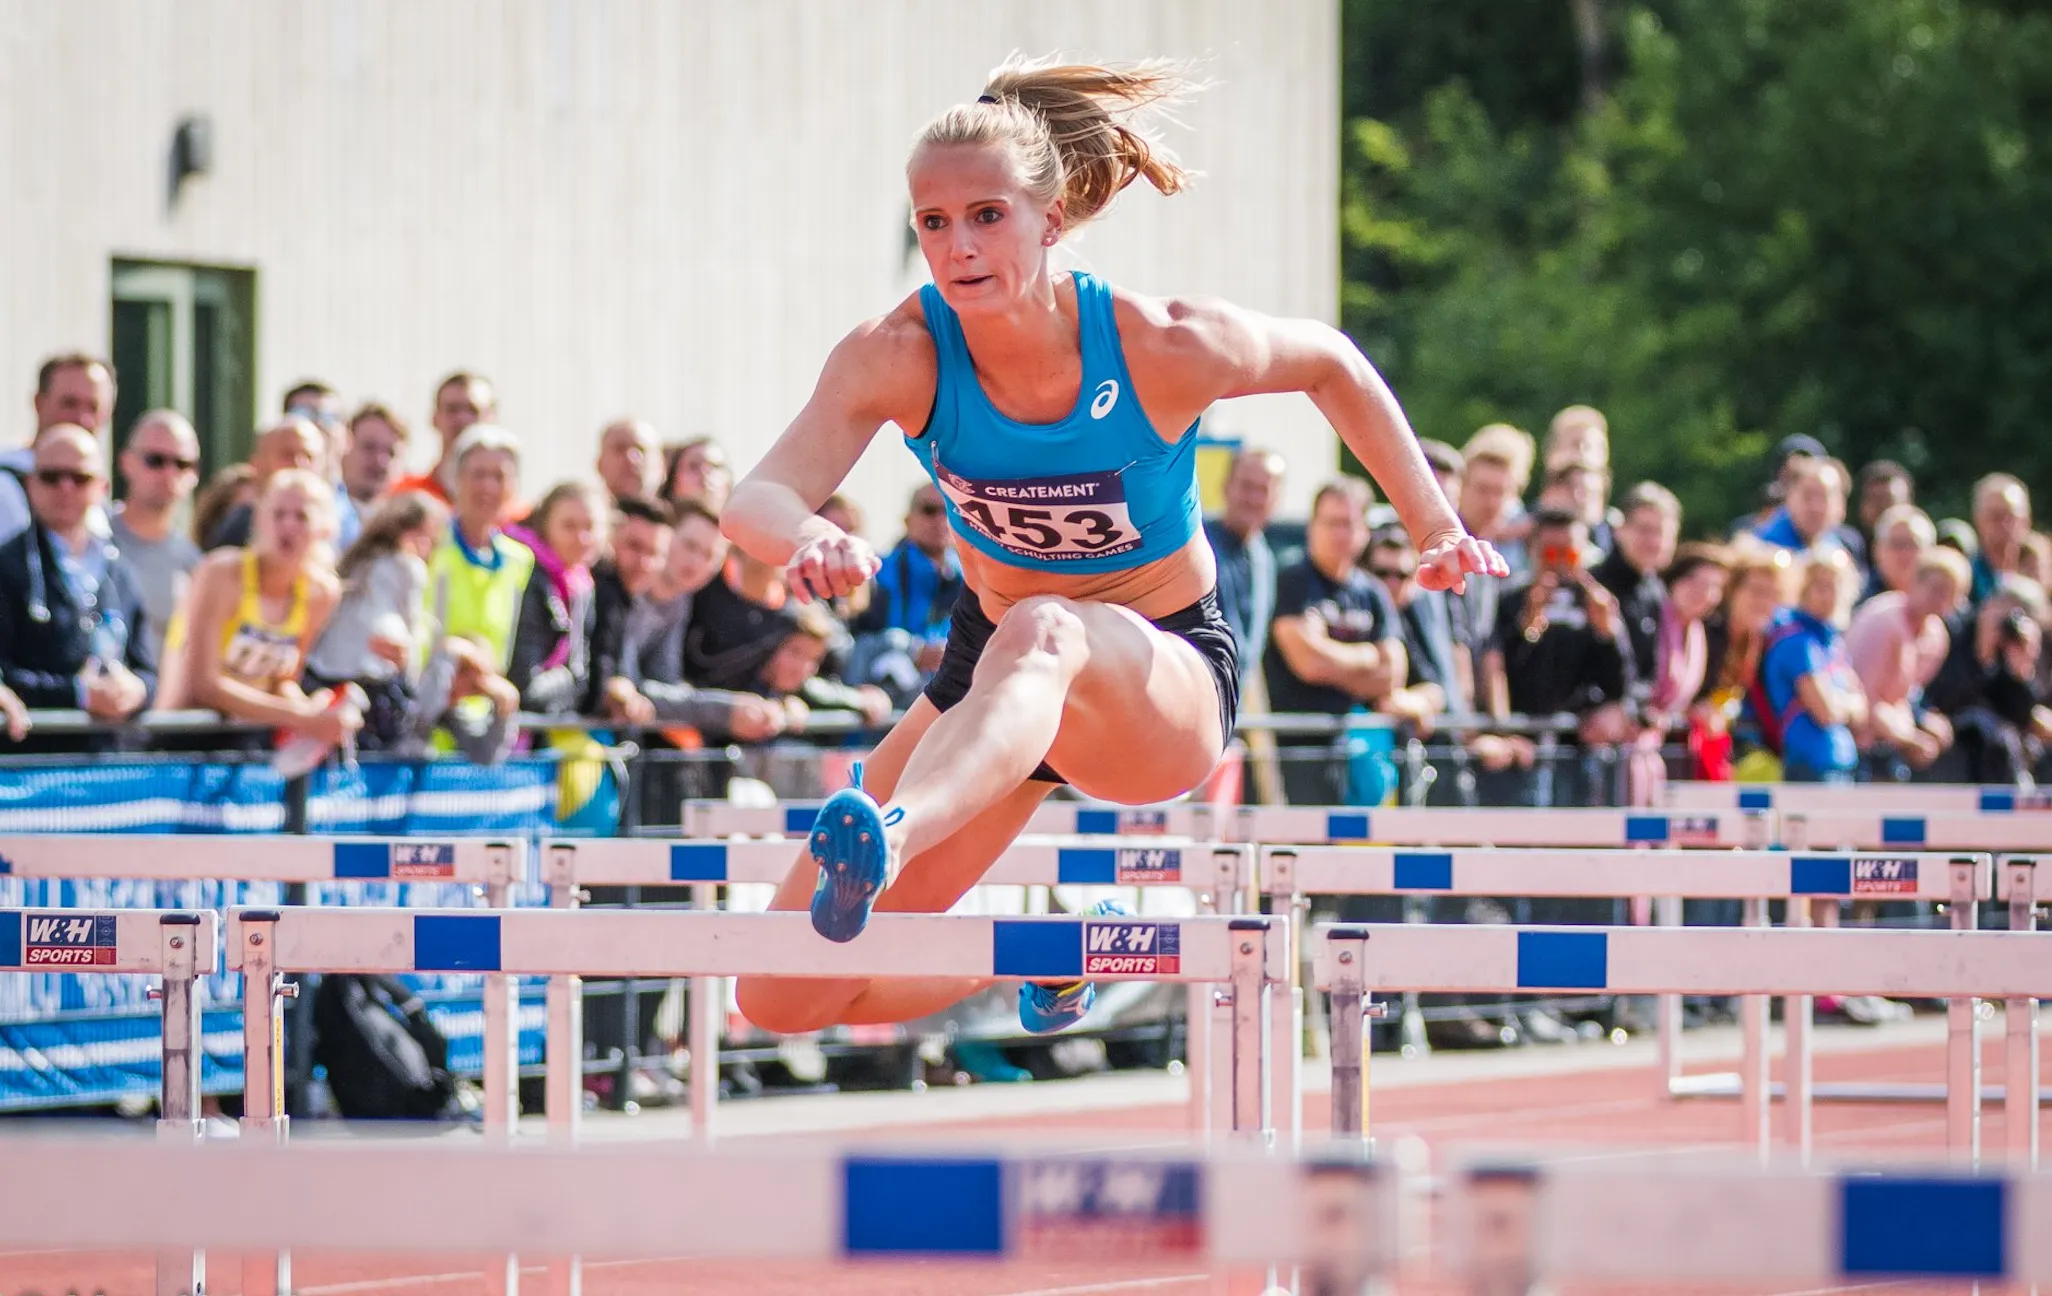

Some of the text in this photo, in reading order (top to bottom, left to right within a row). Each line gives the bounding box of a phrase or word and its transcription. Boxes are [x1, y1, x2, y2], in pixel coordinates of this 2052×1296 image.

[984, 482, 1097, 499] CREATEMENT
[1006, 545, 1082, 561] SCHULTING
[1085, 543, 1134, 559] GAMES
[1855, 860, 1902, 879] W&H
[29, 918, 93, 943] W&H
[1088, 926, 1156, 952] W&H
[28, 949, 94, 963] SPORTS
[1088, 957, 1157, 973] SPORTS
